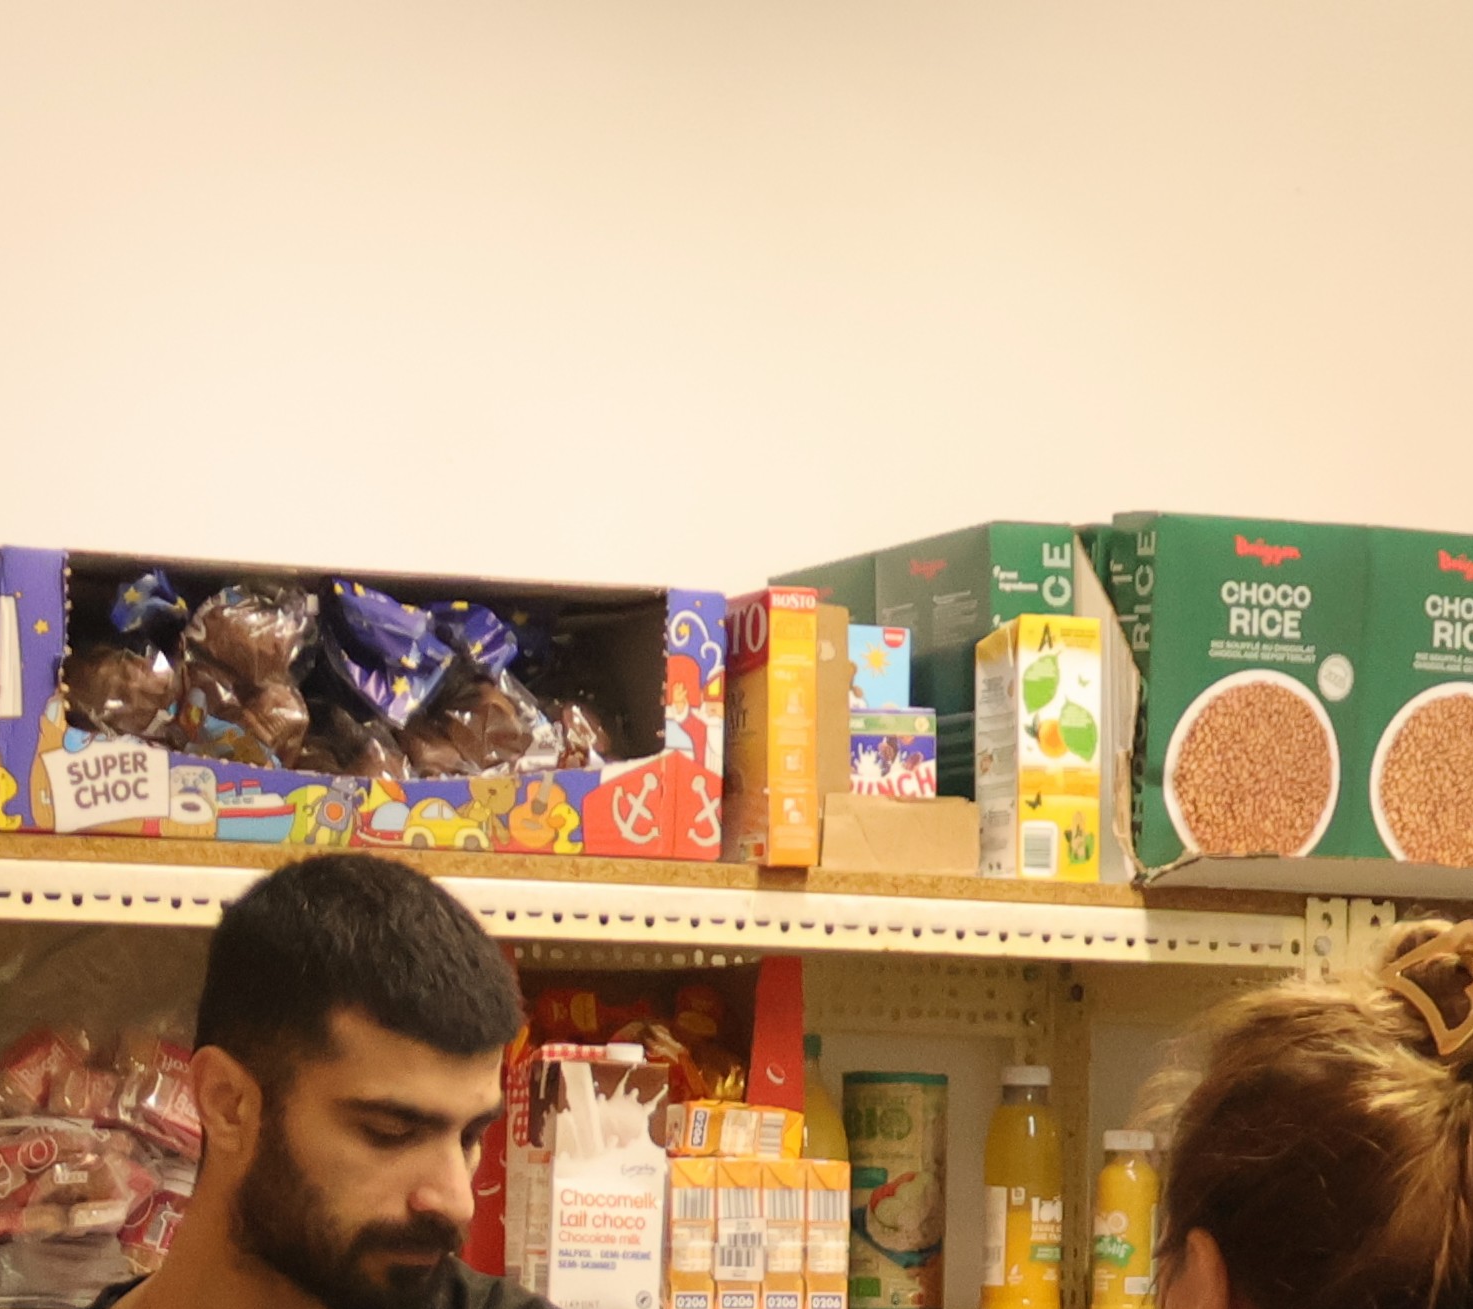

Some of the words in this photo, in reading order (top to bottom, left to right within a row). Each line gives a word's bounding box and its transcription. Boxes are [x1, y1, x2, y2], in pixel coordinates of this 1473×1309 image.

[772, 593, 817, 610] BOSTO
[1221, 581, 1312, 610] CHOCO
[1229, 607, 1302, 639] RICE
[67, 752, 149, 788] SUPER
[74, 778, 151, 811] CHOC
[693, 1110, 707, 1146] 0206
[560, 1189, 658, 1209] Chocomelk
[559, 1210, 588, 1228] Lait
[592, 1211, 646, 1230] choco
[558, 1231, 617, 1244] Chocolate
[618, 1233, 641, 1245] milk
[676, 1296, 707, 1308] 0206
[724, 1295, 753, 1308] 0206
[767, 1296, 797, 1308] 0206
[812, 1297, 842, 1309] 0206
